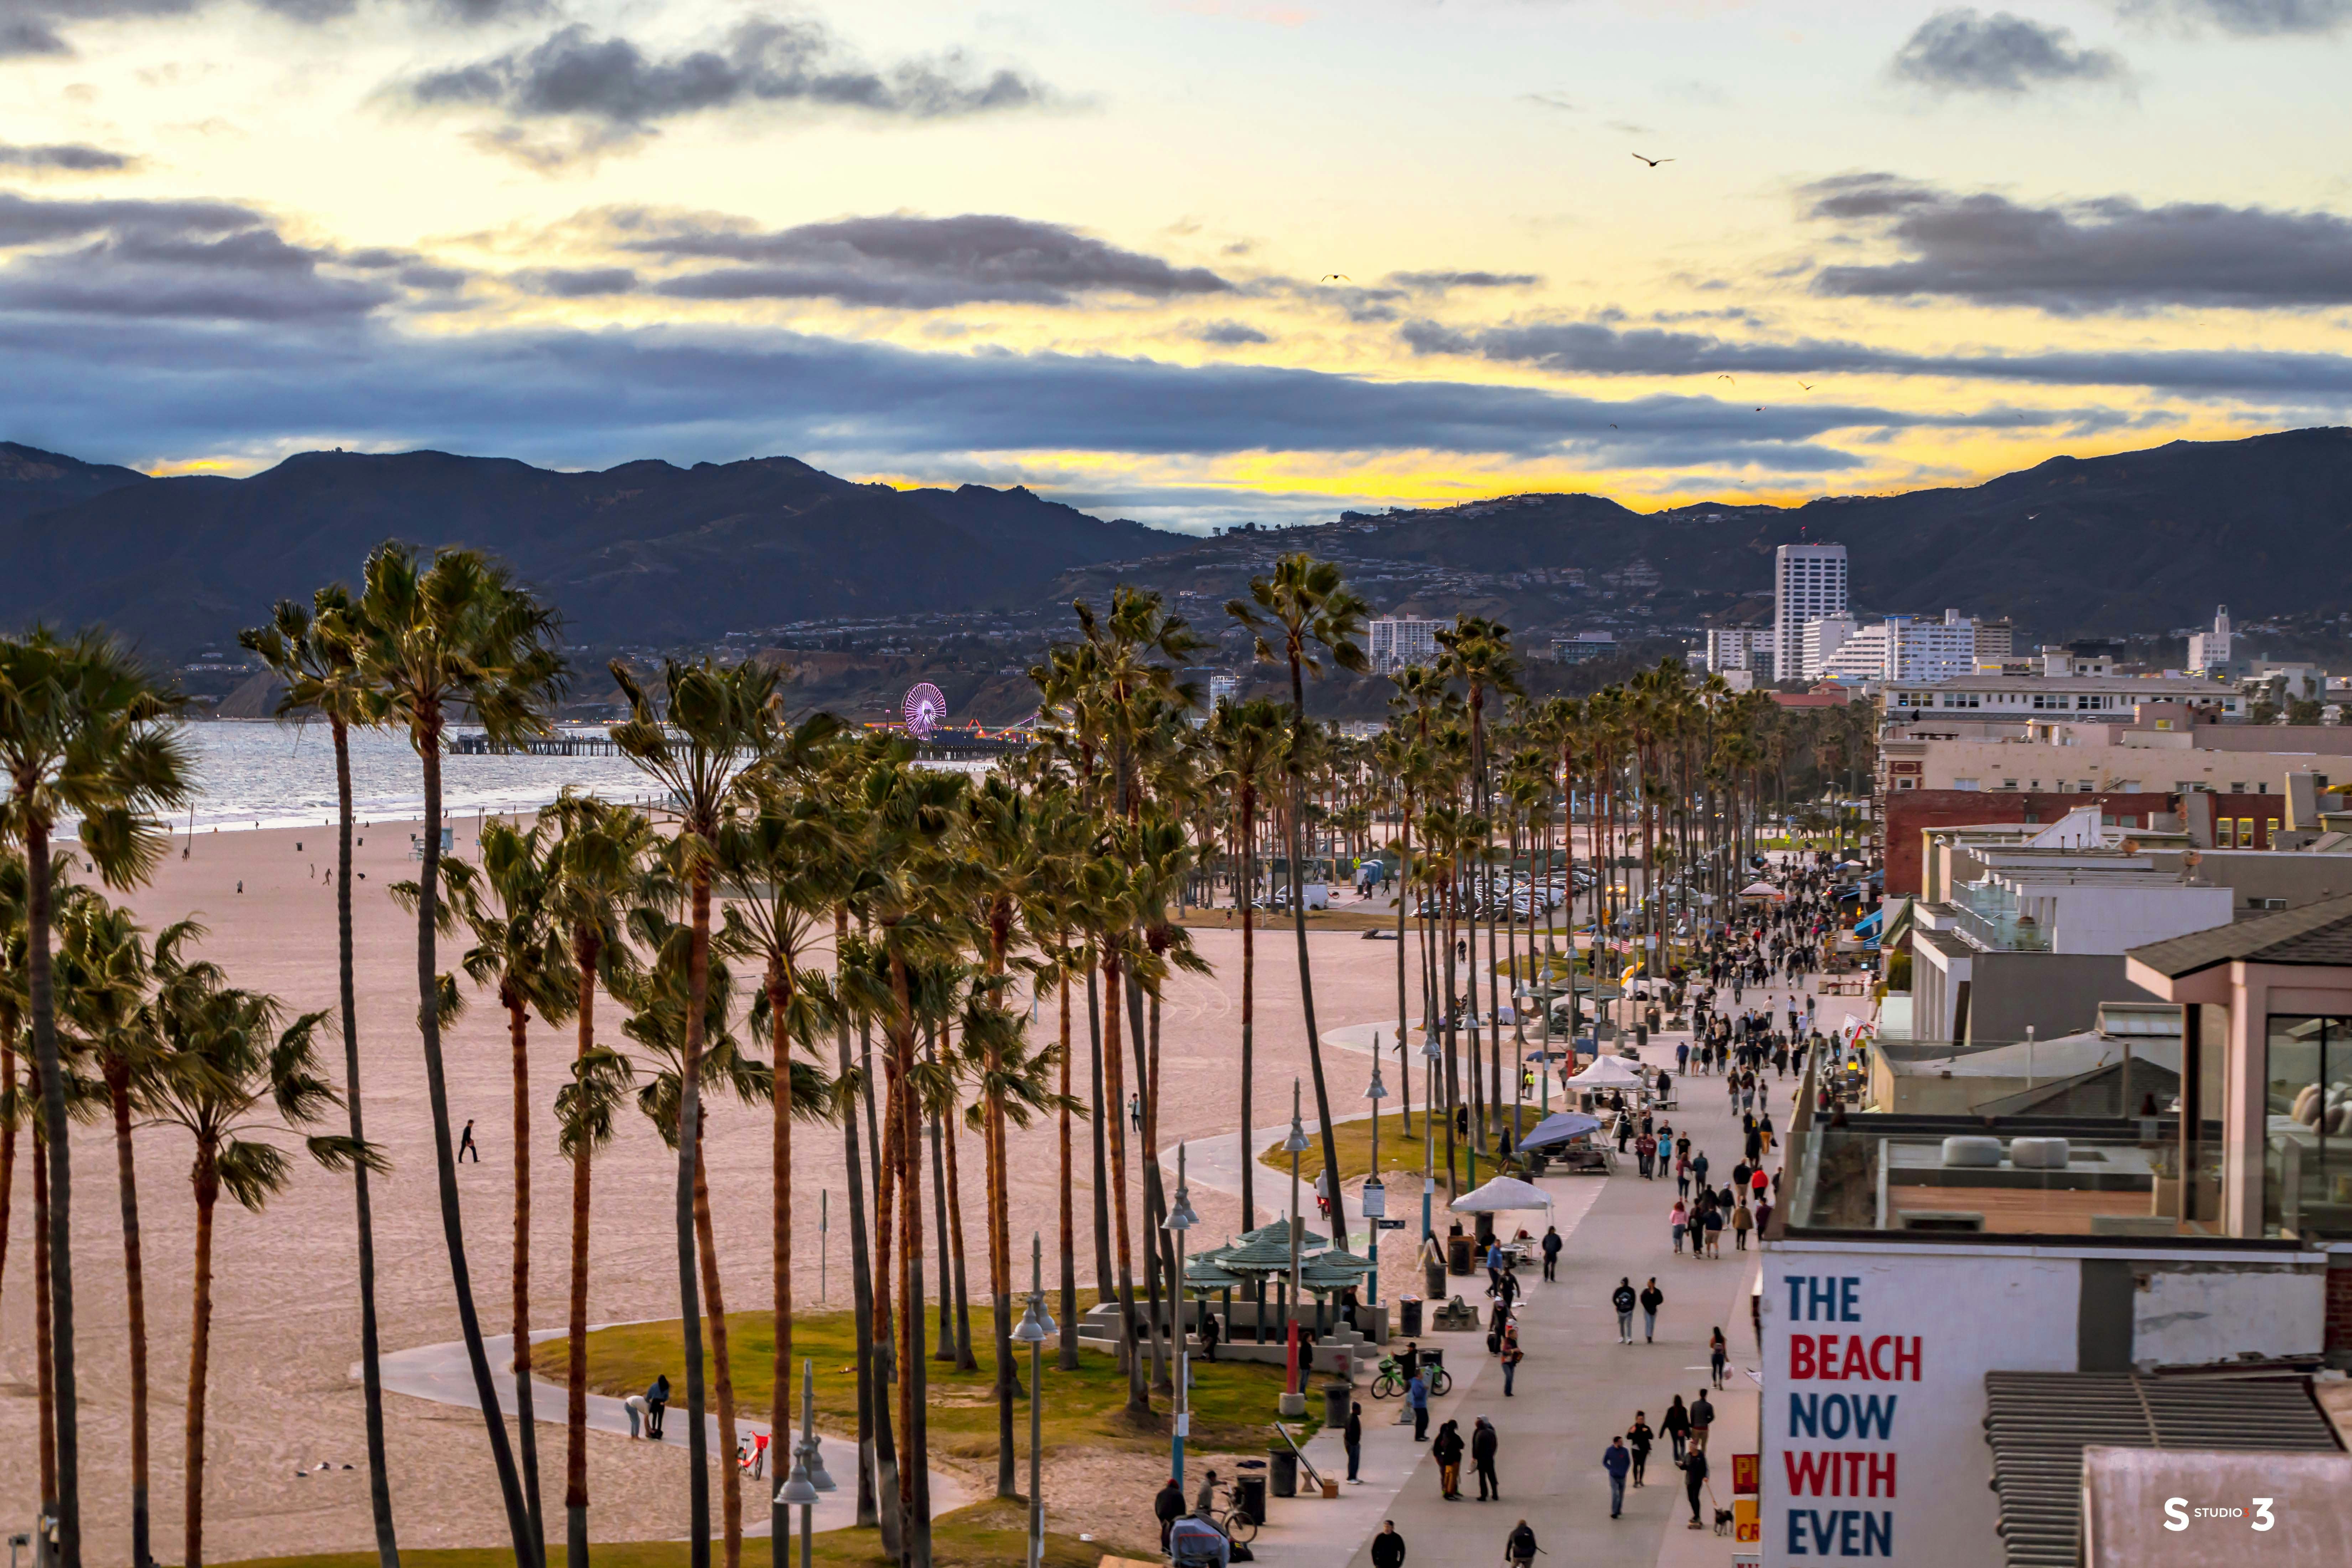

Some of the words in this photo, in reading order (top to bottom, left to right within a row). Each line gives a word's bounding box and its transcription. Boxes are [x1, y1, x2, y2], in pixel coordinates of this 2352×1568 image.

[1784, 1276, 1861, 1322] THE
[1790, 1334, 1922, 1382] BEACH
[1789, 1392, 1897, 1440] NOW
[1783, 1450, 1896, 1498] WITH
[1787, 1509, 1893, 1557] EVEN
